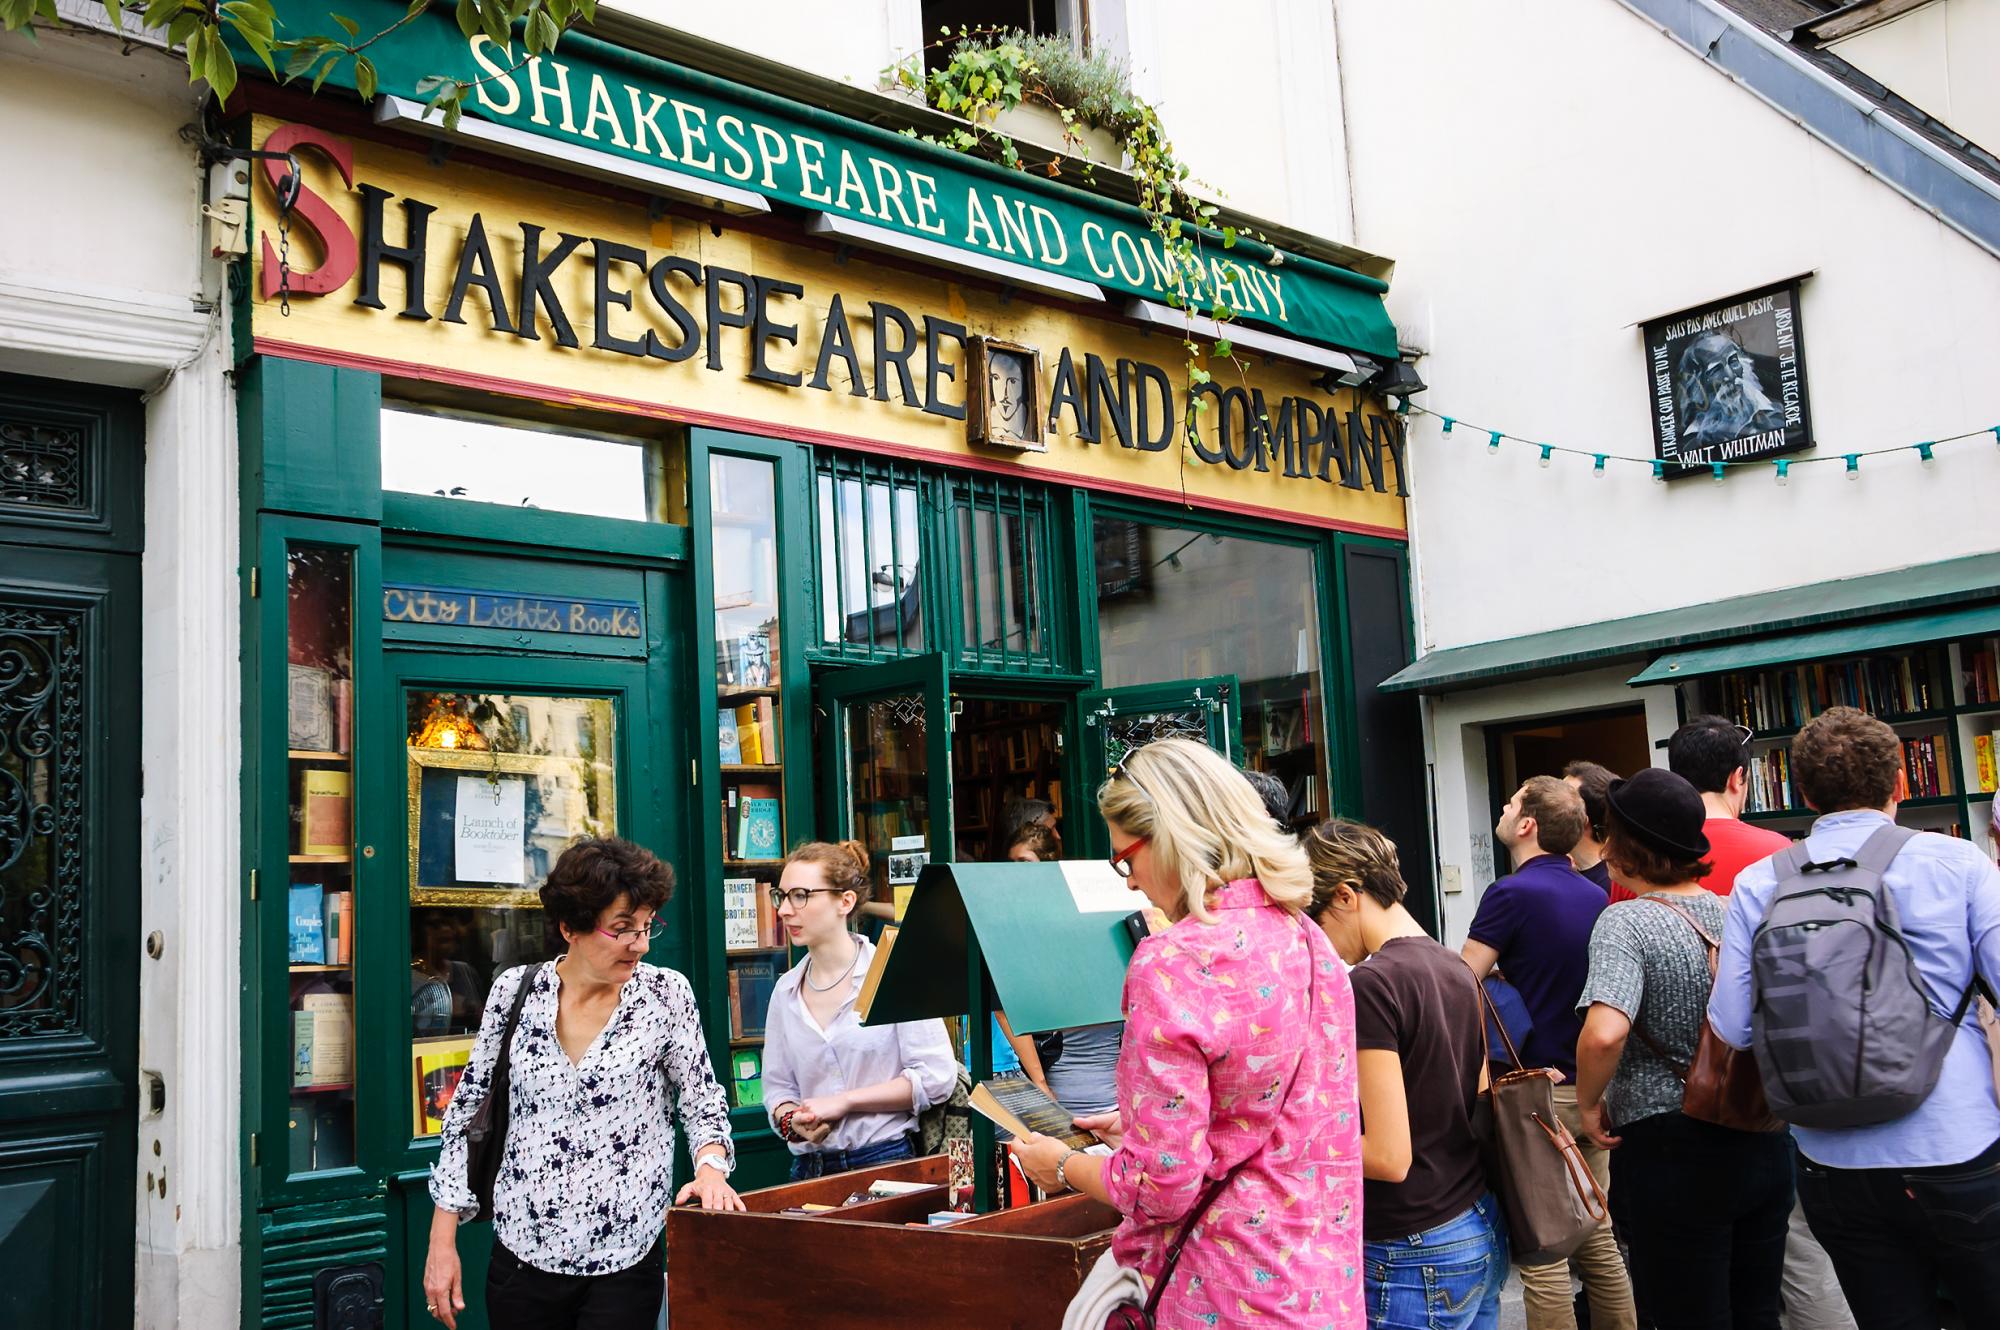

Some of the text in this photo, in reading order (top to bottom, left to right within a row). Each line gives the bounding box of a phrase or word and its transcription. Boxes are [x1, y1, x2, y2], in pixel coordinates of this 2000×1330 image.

[470, 34, 1289, 322] SHAKESPEARE AND COMPANY
[262, 123, 1410, 498] SHAKESPEARE AND COMPANY
[1665, 295, 1775, 342] SAIS PAS AVEC QUEL DESIR
[1774, 306, 1795, 350] ARDENT
[1653, 343, 1668, 361] NE
[1779, 351, 1796, 368] JE
[1654, 360, 1669, 373] TU
[1781, 366, 1797, 382] TE
[1656, 371, 1672, 396] PASSE
[1657, 395, 1674, 413] QUI
[1677, 427, 1786, 470] WALT WHITMAN
[383, 588, 462, 624] City
[467, 595, 561, 633] Lights
[463, 815, 518, 829] Launch of
[460, 827, 519, 841] Booktober
[295, 914, 323, 933] Couples
